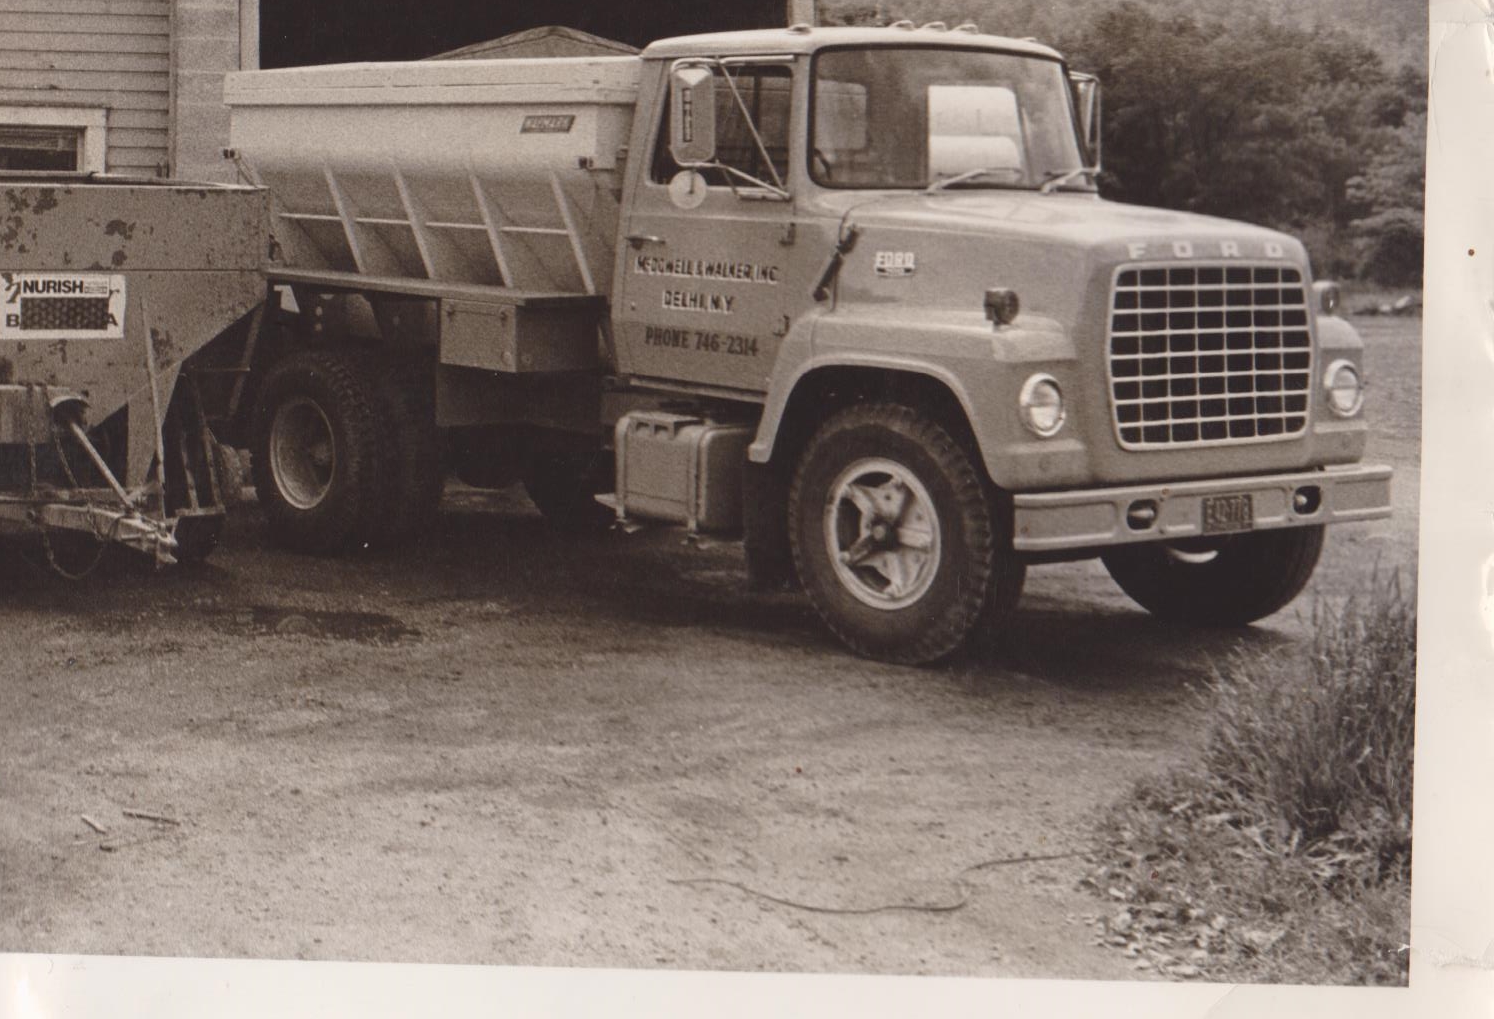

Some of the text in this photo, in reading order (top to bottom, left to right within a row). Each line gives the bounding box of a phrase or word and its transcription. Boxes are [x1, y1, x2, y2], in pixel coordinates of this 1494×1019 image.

[1127, 240, 1284, 259] FORD
[876, 251, 915, 267] FORD
[23, 280, 84, 294] NURISH
[644, 326, 689, 348] PHONE
